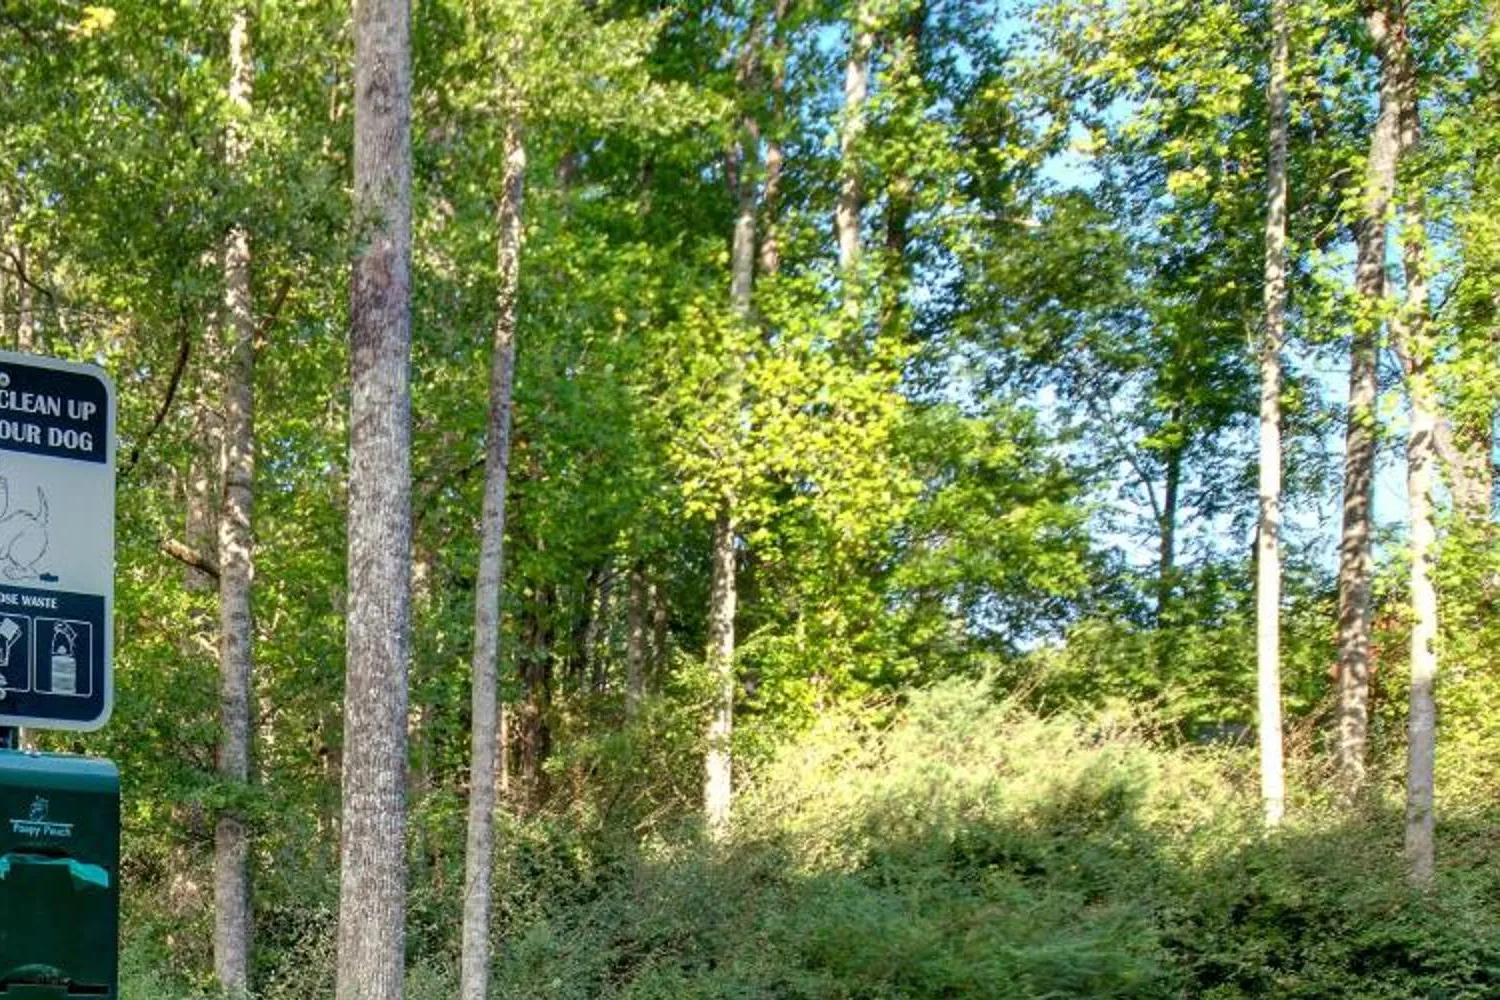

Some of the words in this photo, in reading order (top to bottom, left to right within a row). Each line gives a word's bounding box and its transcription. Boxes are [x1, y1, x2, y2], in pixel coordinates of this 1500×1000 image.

[68, 399, 97, 421] UP
[48, 427, 94, 452] DOG
[21, 594, 59, 609] WASTE
